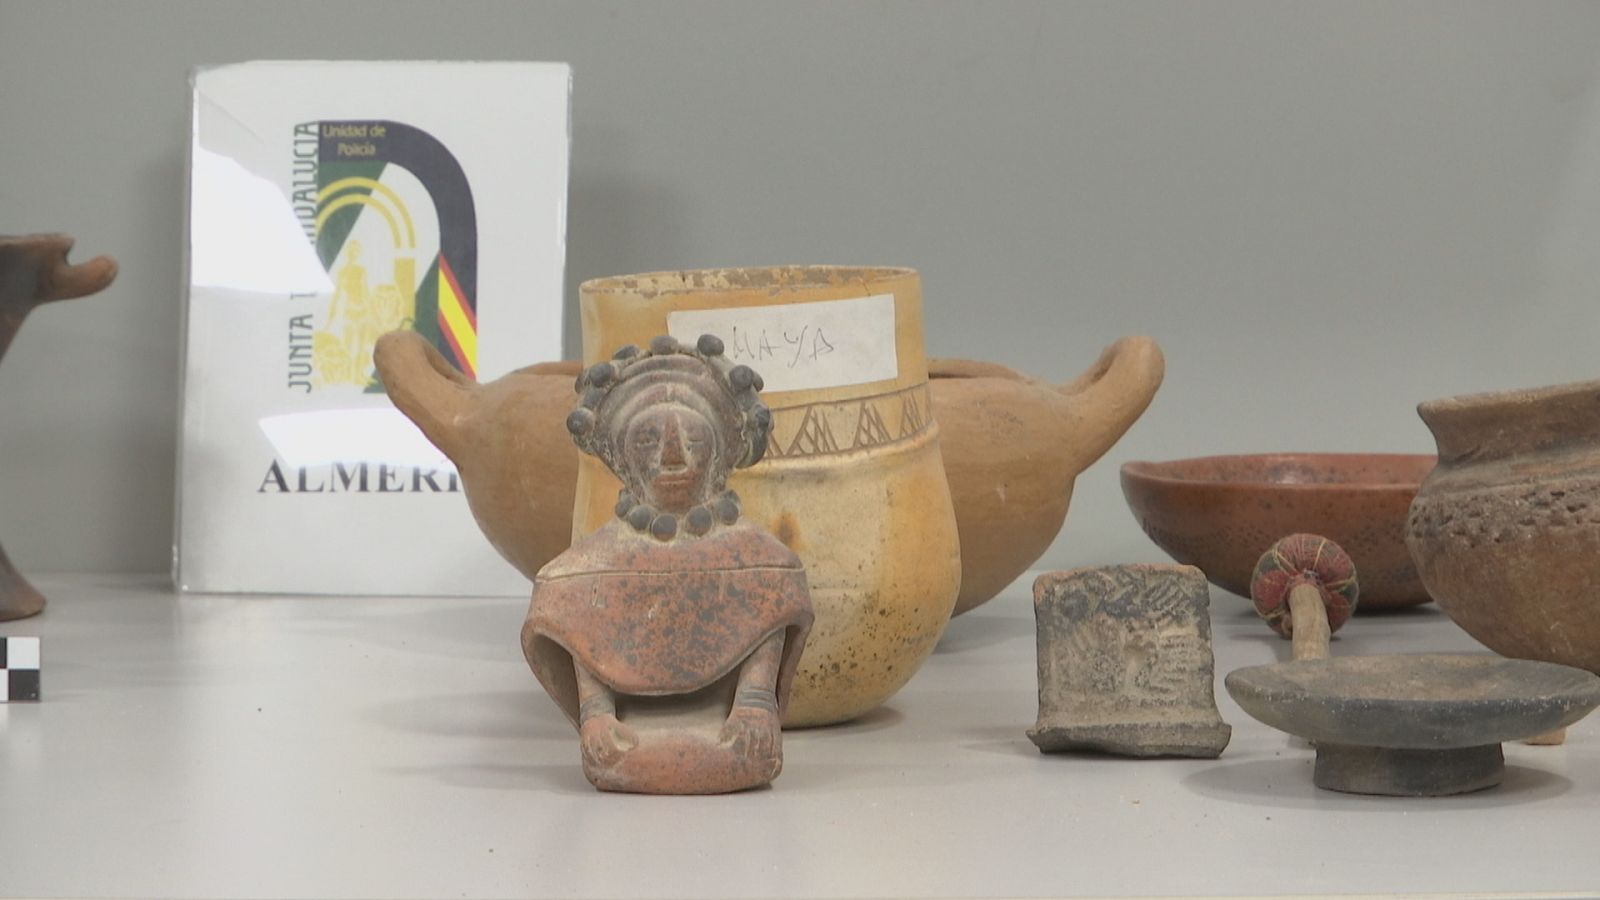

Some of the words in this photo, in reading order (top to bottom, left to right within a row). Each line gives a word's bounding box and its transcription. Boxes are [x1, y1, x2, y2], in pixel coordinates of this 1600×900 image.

[322, 124, 368, 138] Unidad
[370, 124, 387, 137] de
[293, 121, 319, 245] DALUCIA
[288, 313, 314, 394] JUNTA
[732, 325, 835, 368] MAYA
[257, 458, 461, 493] ALMERI
